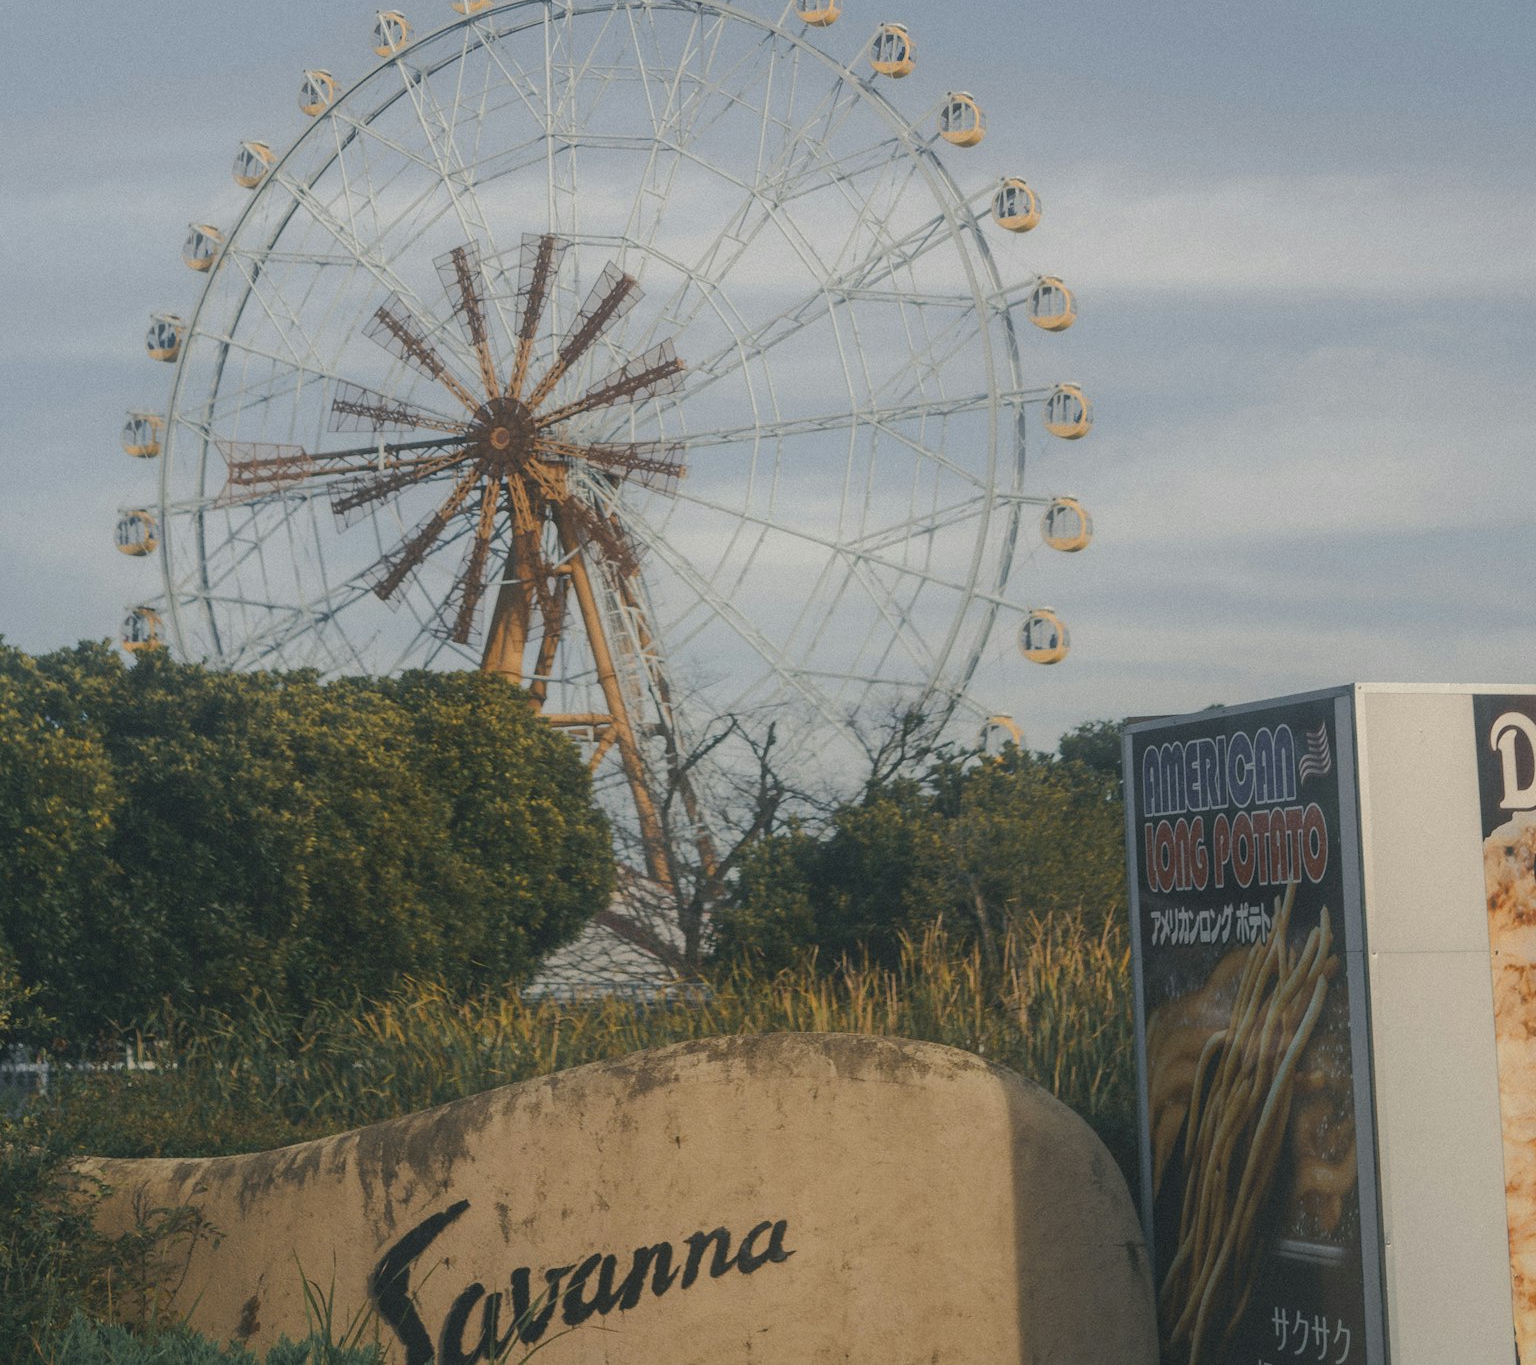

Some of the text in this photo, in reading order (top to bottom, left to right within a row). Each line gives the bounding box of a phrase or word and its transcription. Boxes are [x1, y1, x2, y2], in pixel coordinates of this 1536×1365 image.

[1143, 724, 1296, 817] AMERICAN
[1145, 802, 1328, 893] LONG POTATO
[367, 1198, 797, 1365] Savanna
[1271, 1306, 1351, 1365] サクサク
